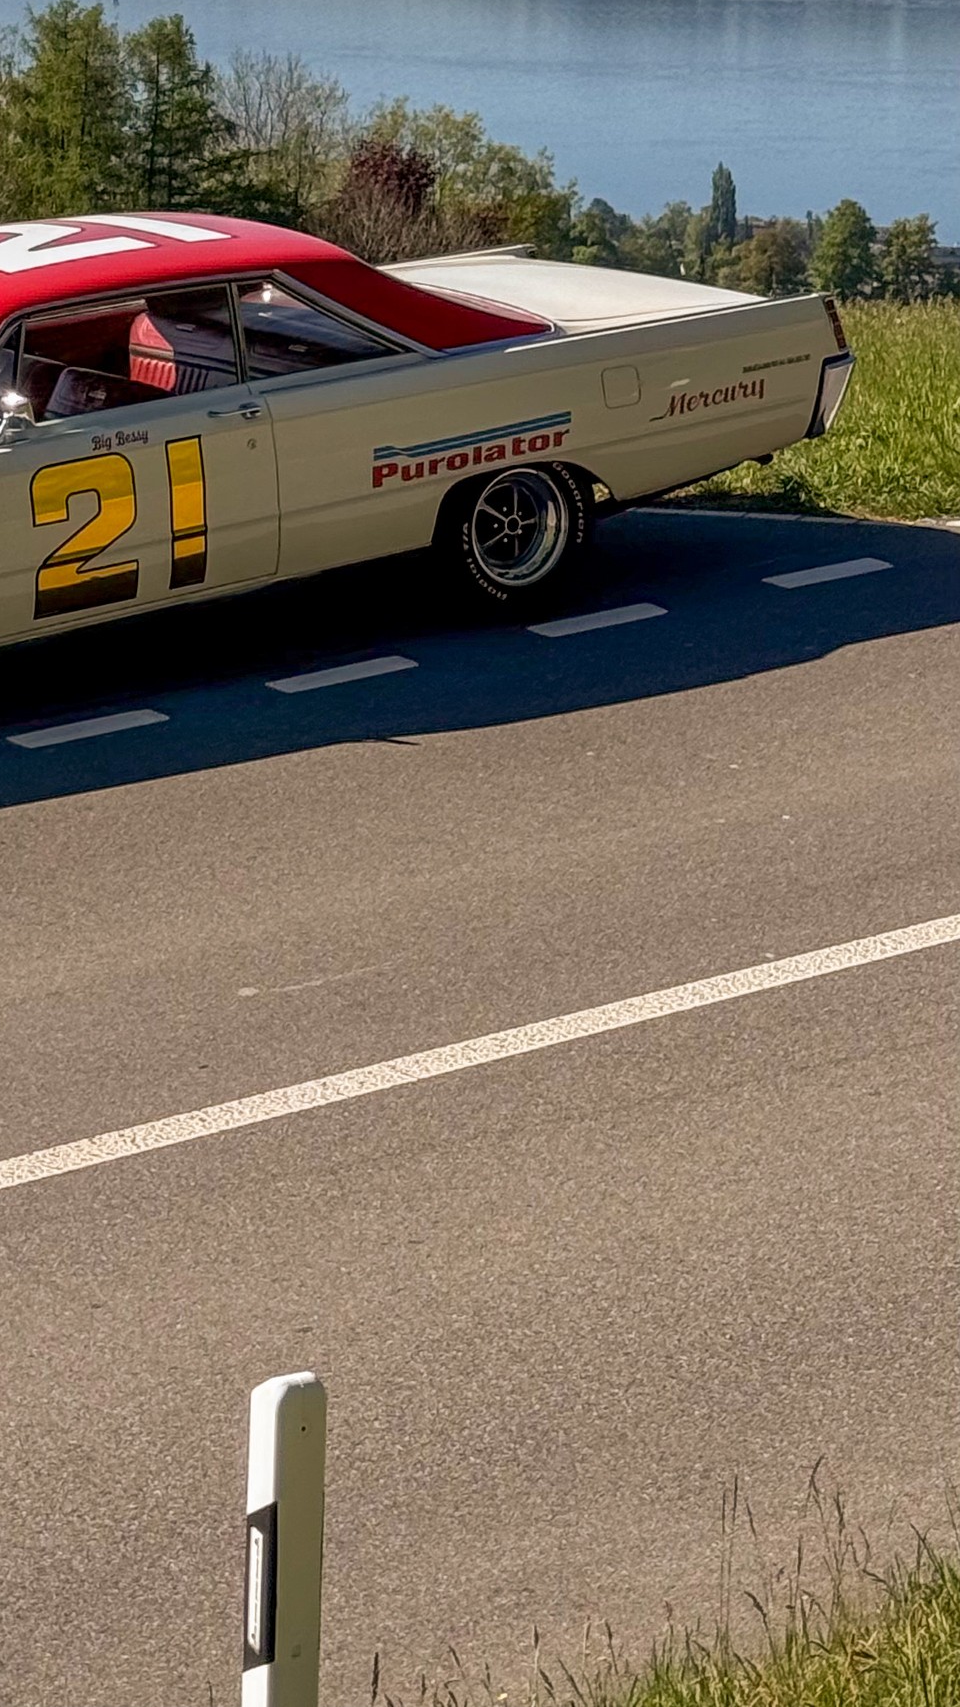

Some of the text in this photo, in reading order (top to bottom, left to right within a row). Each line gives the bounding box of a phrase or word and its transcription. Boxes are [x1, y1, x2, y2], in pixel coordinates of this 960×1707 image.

[649, 379, 765, 423] Mercury
[91, 430, 149, 451] Big Bessy
[372, 429, 570, 488] Purolator
[29, 434, 208, 620] 21
